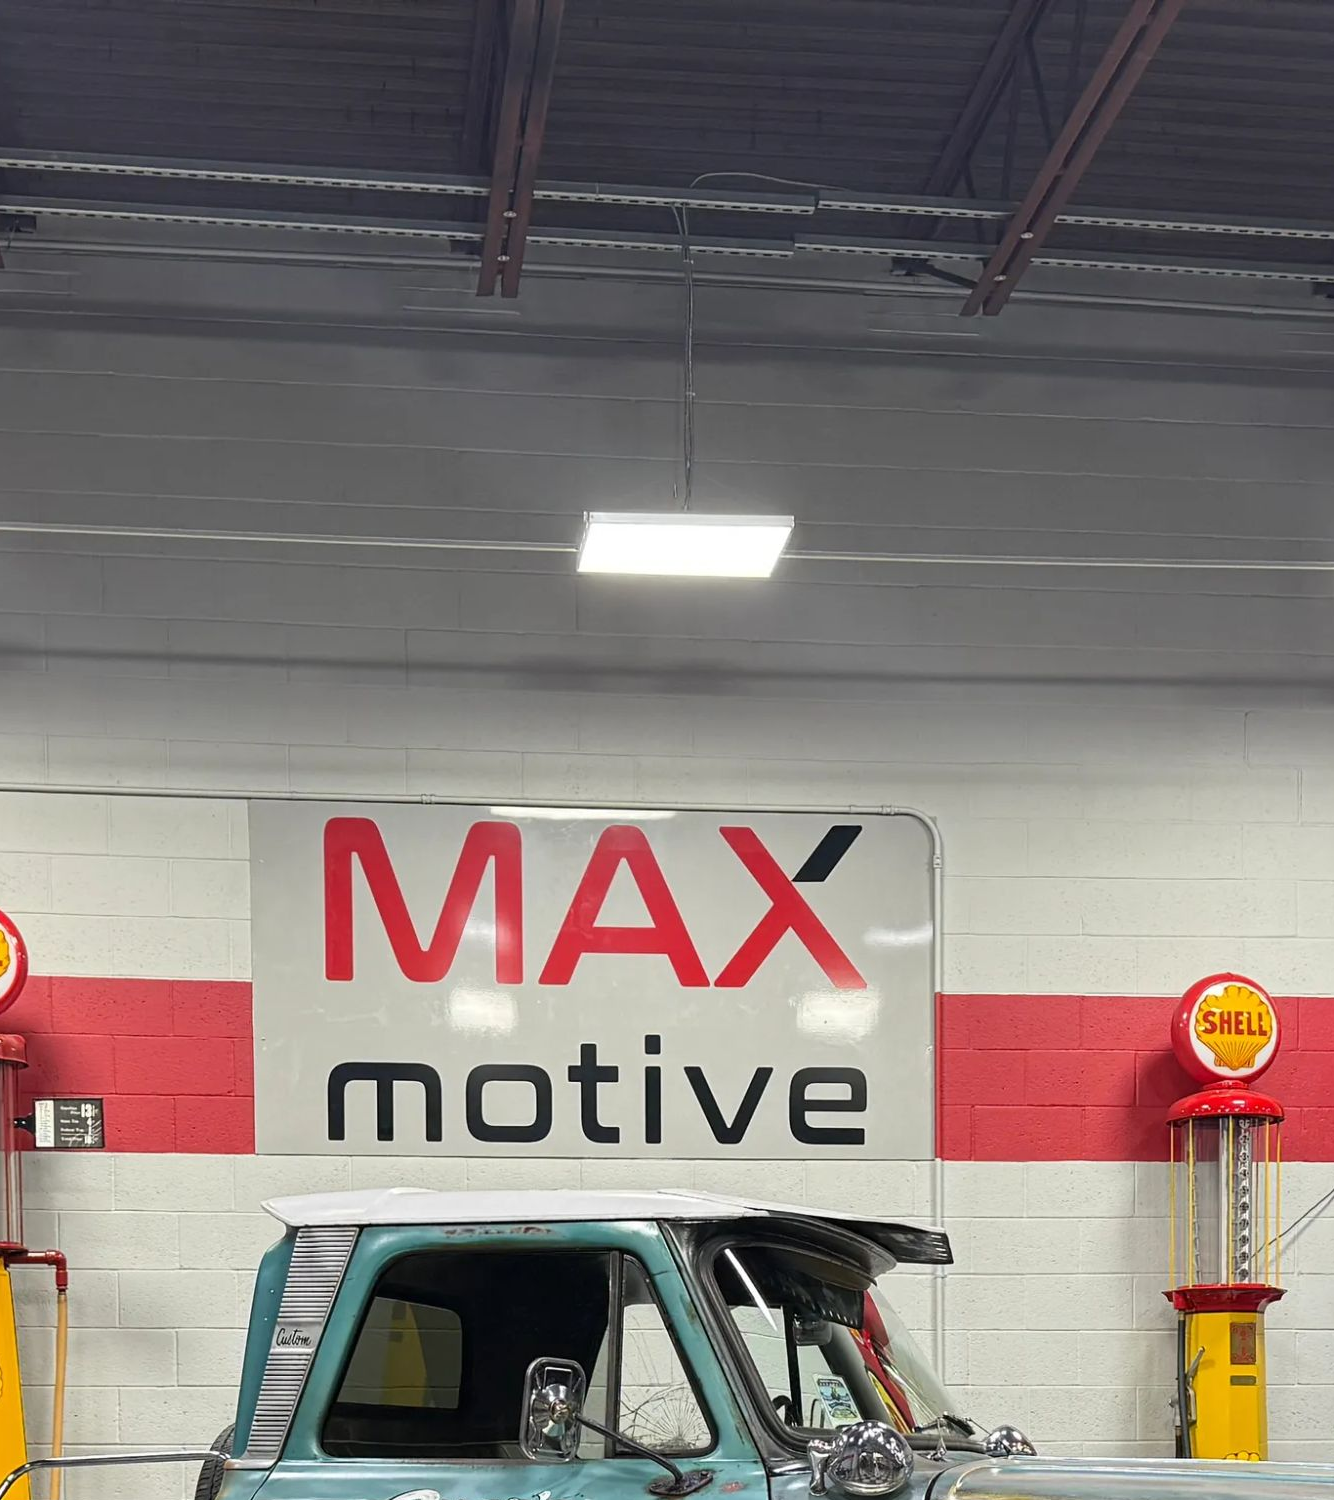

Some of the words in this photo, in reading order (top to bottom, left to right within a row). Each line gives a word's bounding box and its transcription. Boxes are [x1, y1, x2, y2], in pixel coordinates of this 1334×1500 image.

[323, 816, 867, 989] MAX
[1202, 1009, 1268, 1037] SHELL
[327, 1034, 868, 1145] motive
[275, 1327, 312, 1346] Custom
